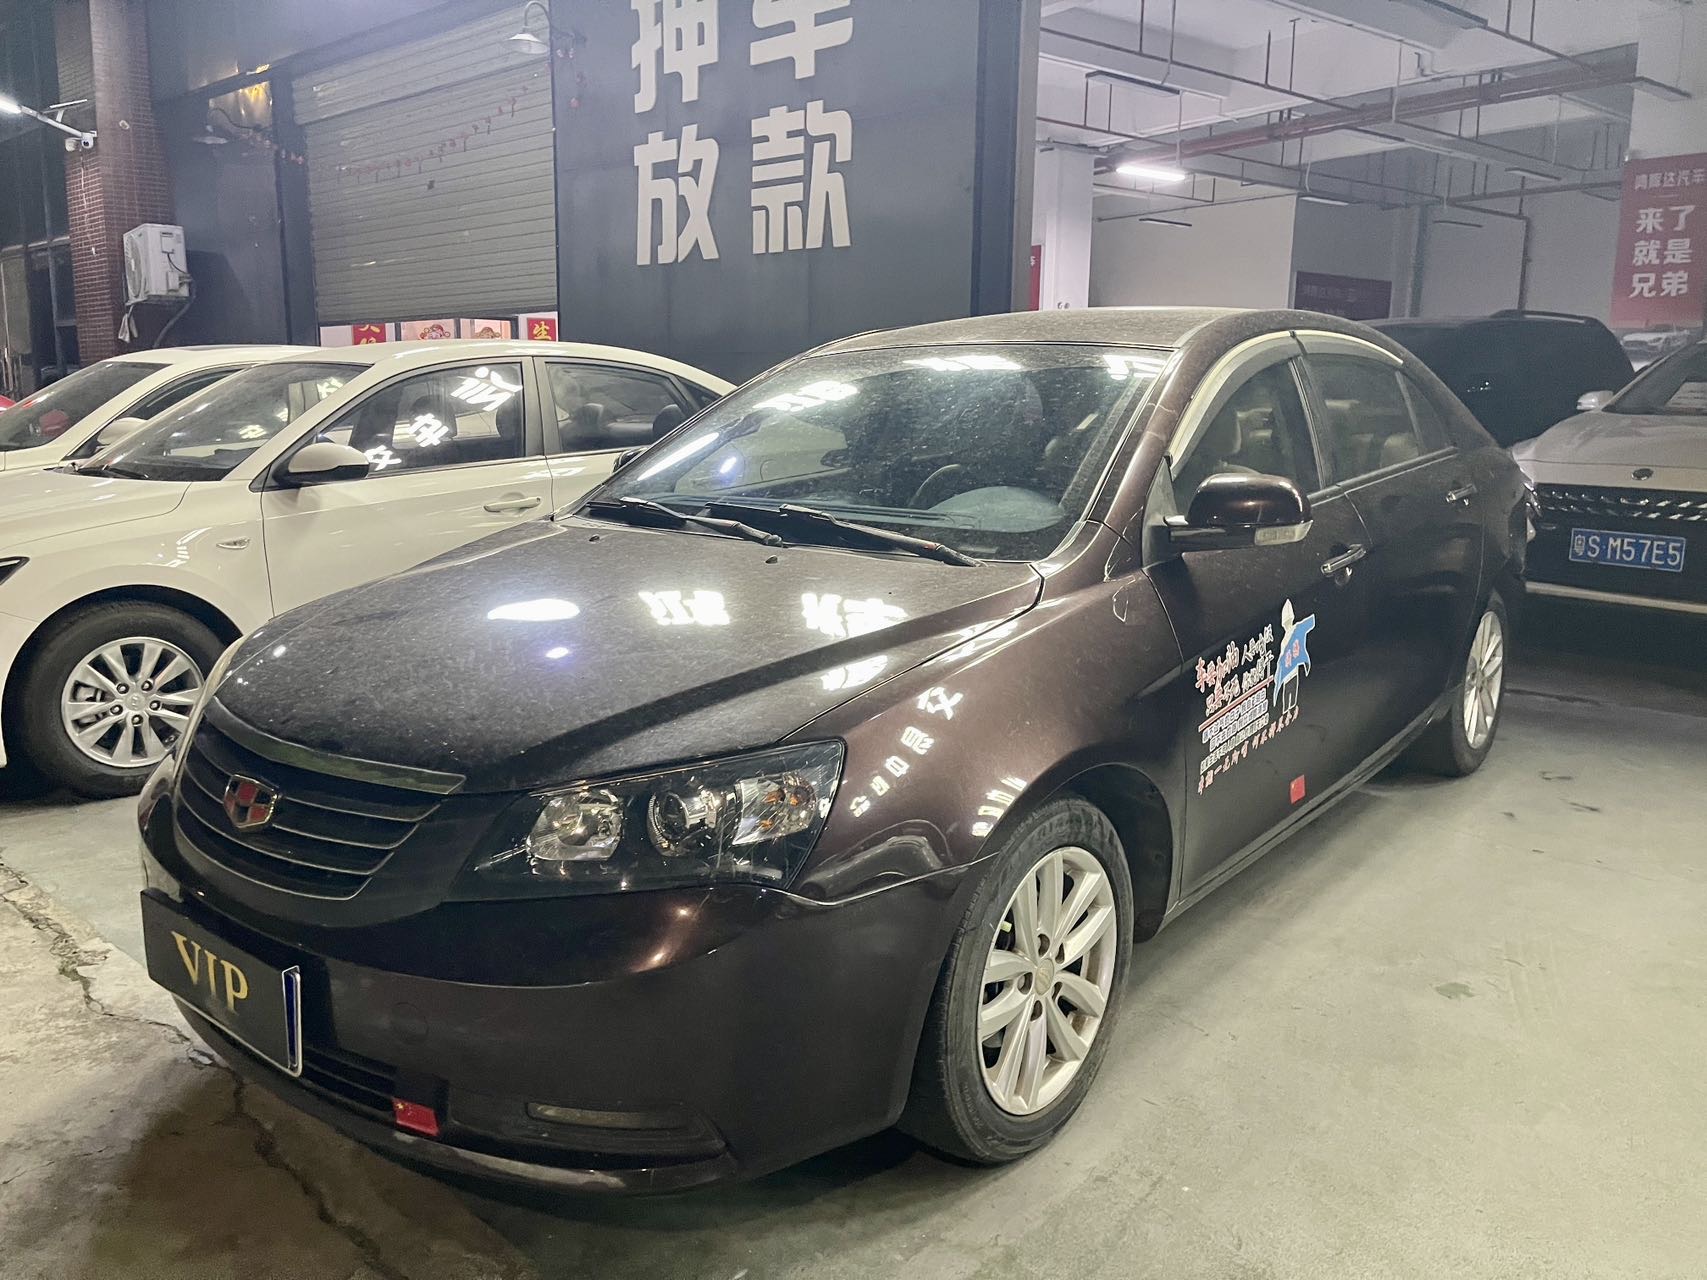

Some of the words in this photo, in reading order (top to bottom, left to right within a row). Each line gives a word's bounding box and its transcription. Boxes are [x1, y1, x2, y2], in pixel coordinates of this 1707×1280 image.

[634, 100, 853, 265] 放款
[1636, 204, 1696, 234] 来了
[1631, 238, 1692, 266] 就是
[1628, 270, 1689, 298] 兄弟
[171, 930, 249, 1016] VIP
